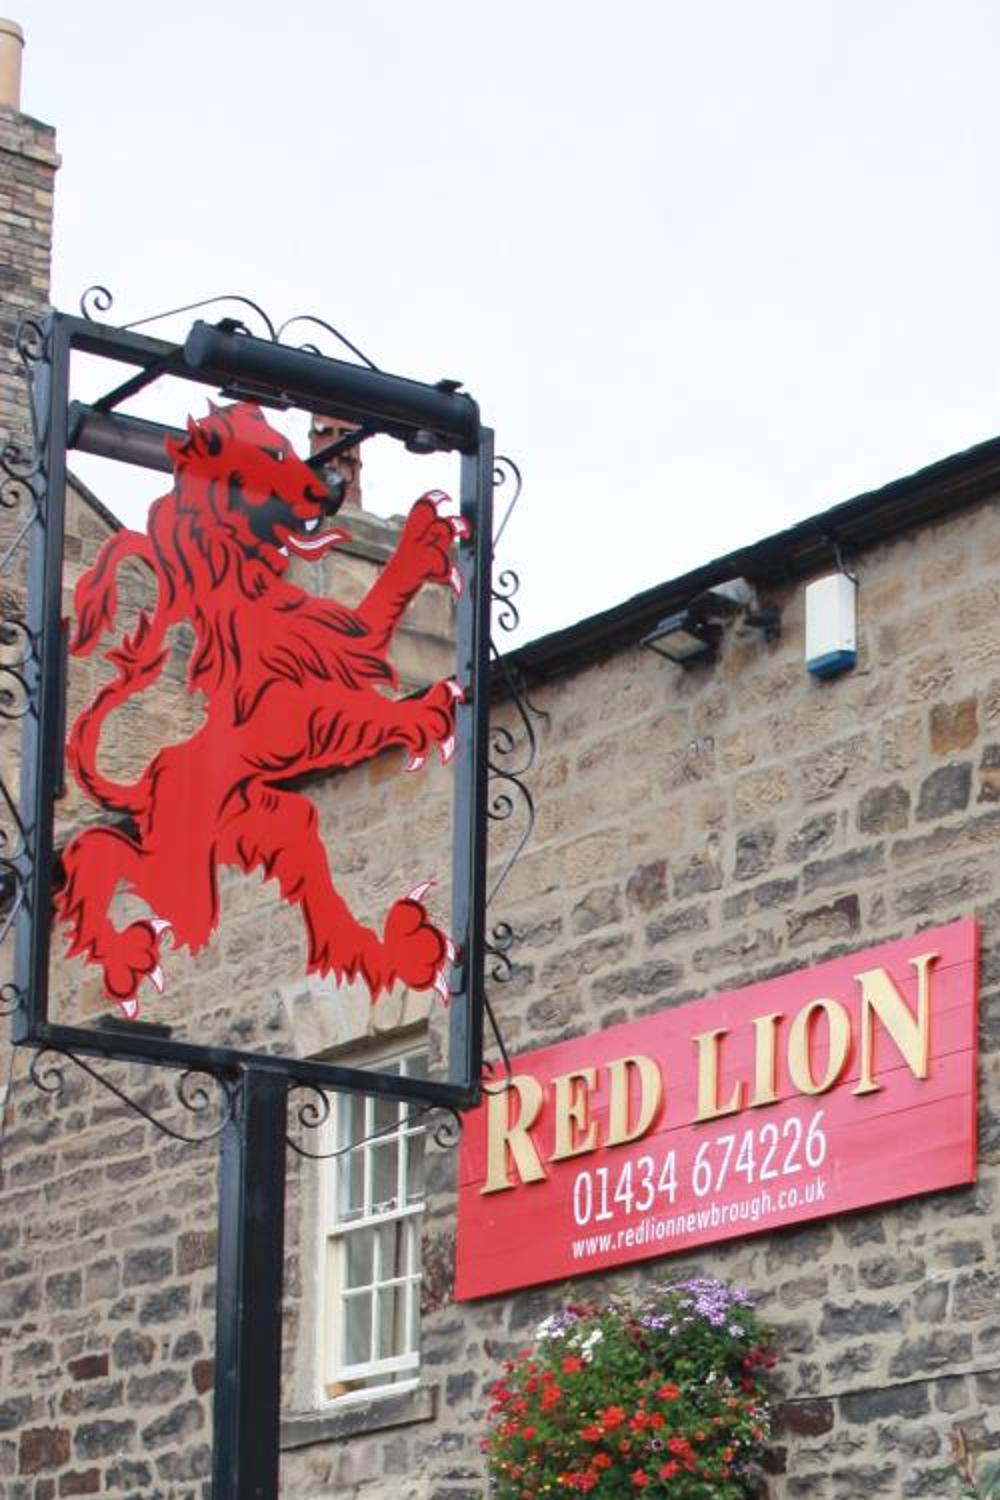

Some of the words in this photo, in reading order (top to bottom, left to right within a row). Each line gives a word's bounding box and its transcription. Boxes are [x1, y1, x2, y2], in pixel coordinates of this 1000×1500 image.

[480, 1055, 664, 1196] RED
[693, 951, 941, 1126] LION
[571, 1175, 827, 1260] www.redlionnewbrough.co.uk
[573, 1149, 678, 1226] 01434
[692, 1110, 827, 1198] 674226
